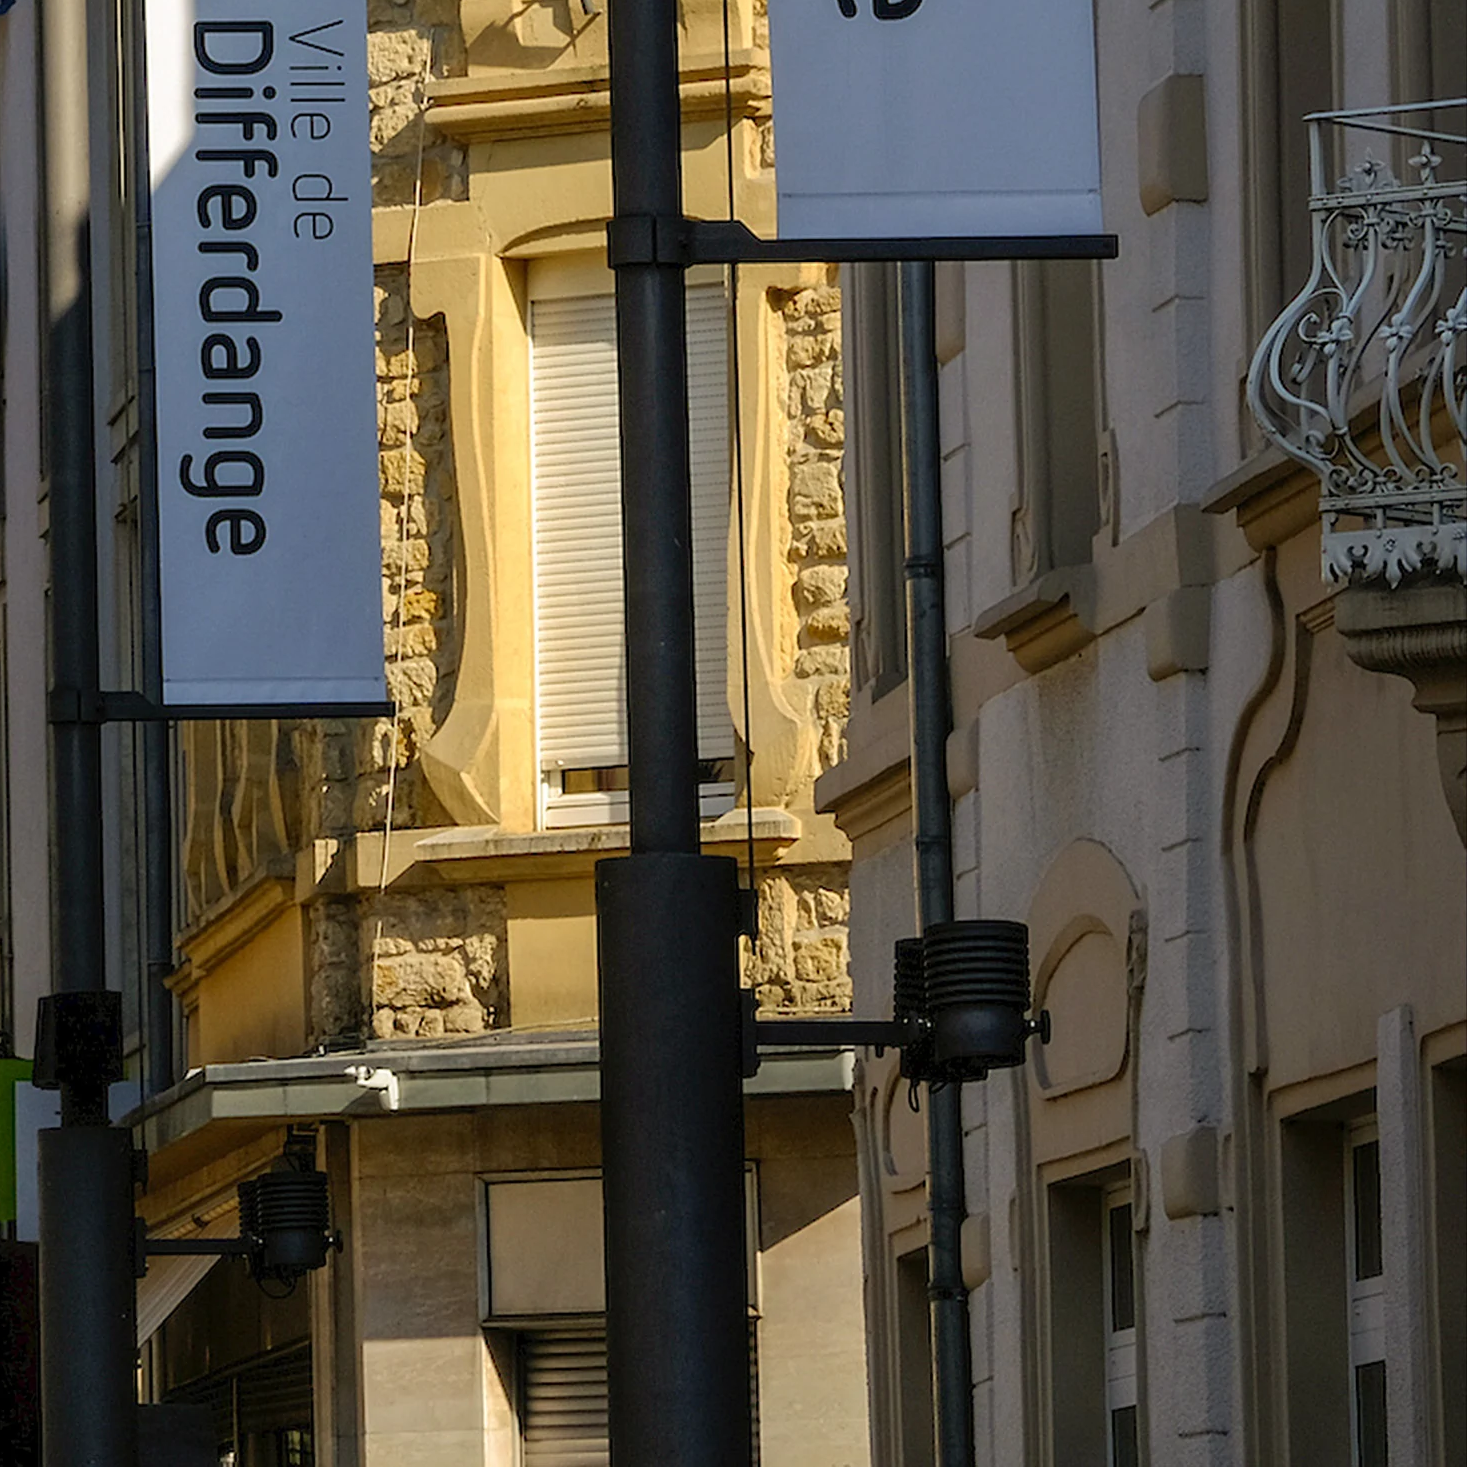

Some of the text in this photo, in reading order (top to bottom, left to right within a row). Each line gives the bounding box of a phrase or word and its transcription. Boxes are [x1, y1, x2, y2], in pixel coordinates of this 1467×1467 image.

[179, 18, 283, 557] Differdange
[288, 19, 349, 242] Ville de
